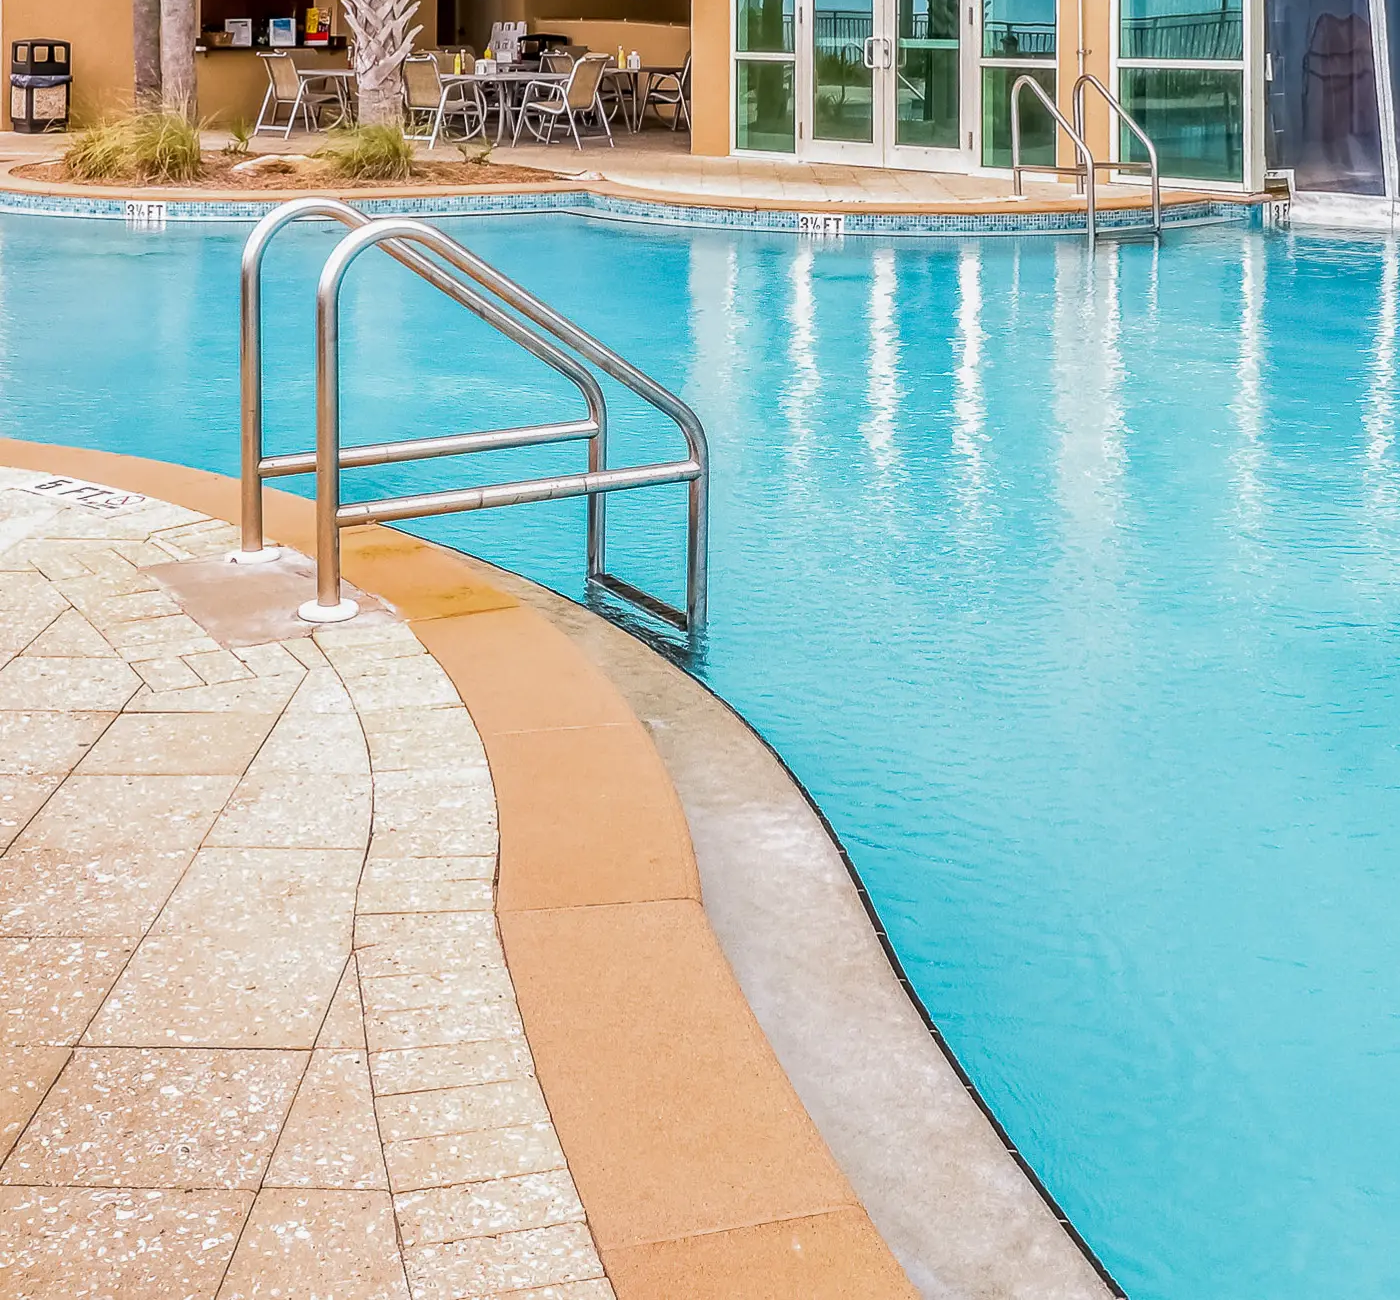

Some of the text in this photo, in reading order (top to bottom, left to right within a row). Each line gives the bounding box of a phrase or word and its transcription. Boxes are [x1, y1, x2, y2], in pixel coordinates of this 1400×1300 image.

[147, 204, 164, 217] FT
[823, 217, 842, 230] FT
[34, 479, 74, 490] 5
